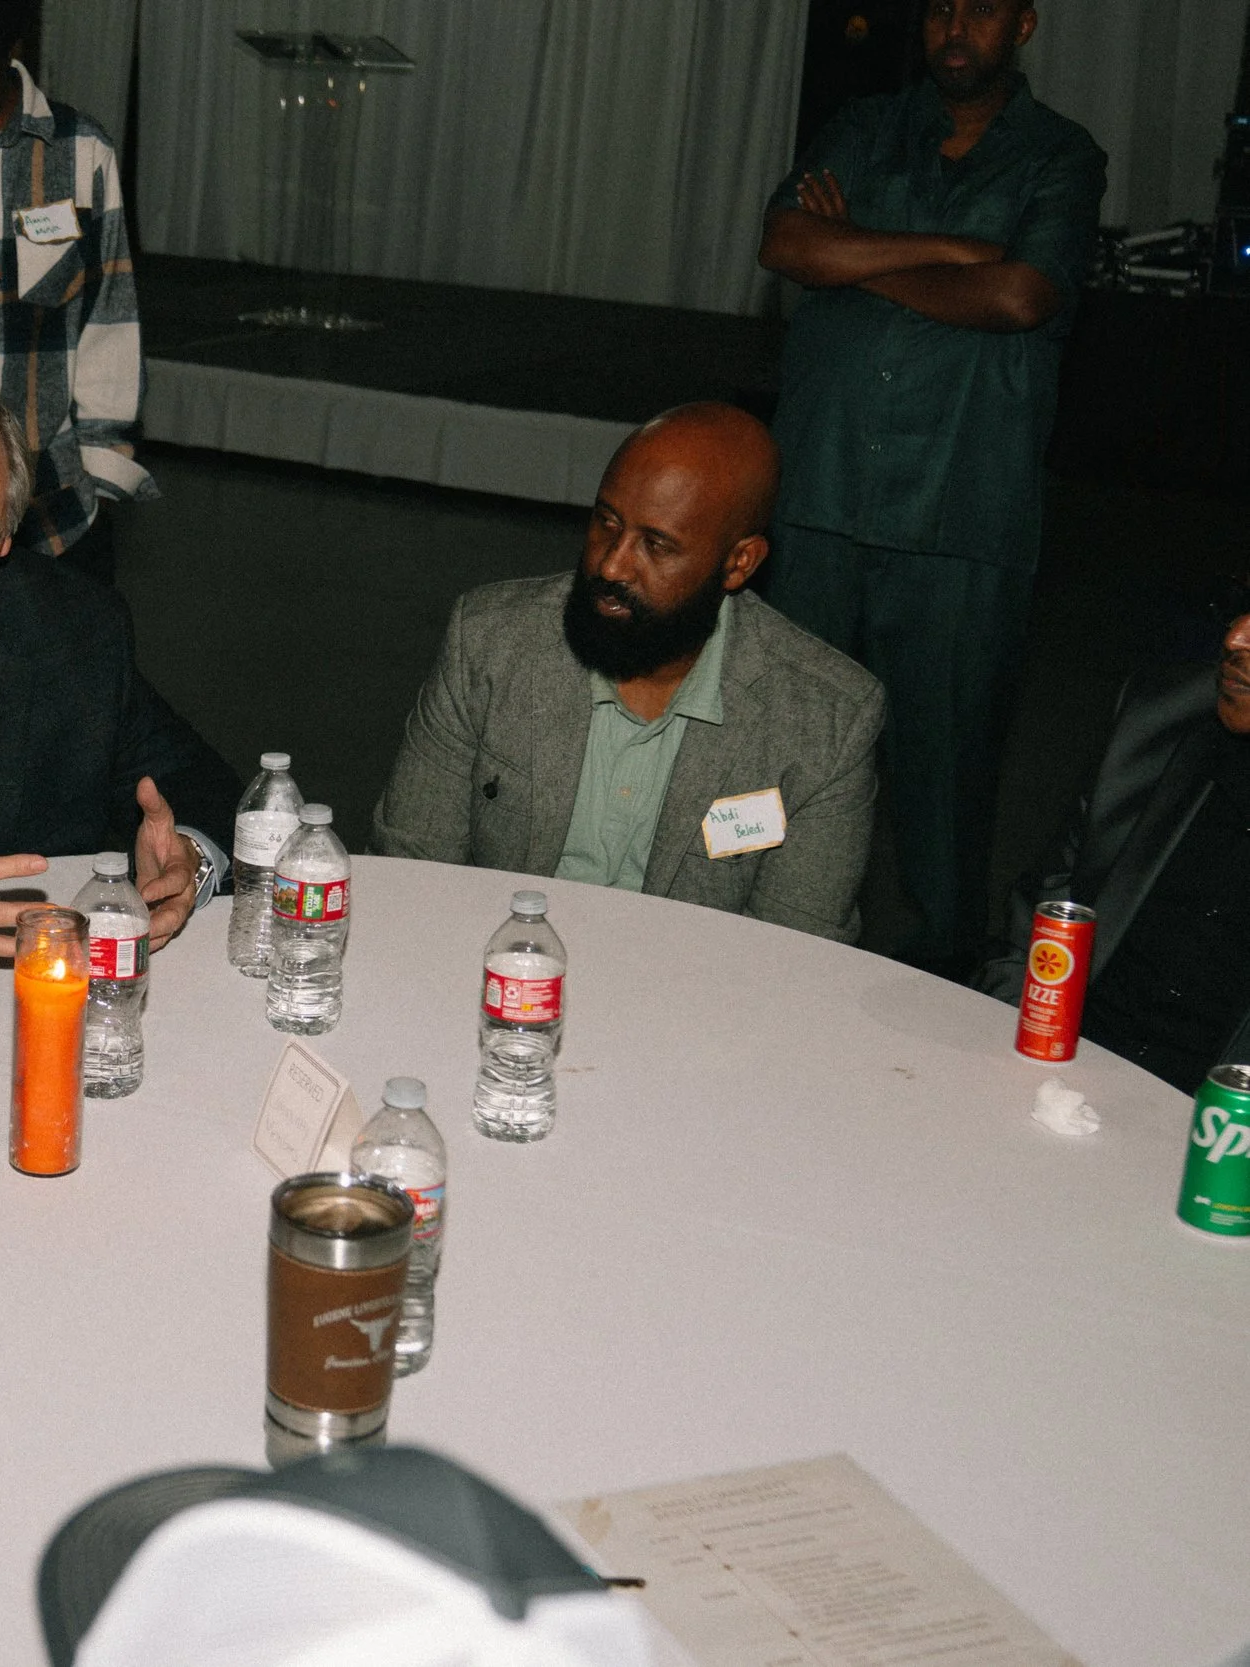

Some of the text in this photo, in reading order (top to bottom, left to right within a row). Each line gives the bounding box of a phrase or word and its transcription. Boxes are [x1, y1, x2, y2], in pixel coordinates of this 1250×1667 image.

[710, 807, 739, 824] Abdi
[734, 822, 765, 838] Beledi
[1028, 983, 1064, 1005] IZZE
[1192, 1106, 1250, 1164] Sp
